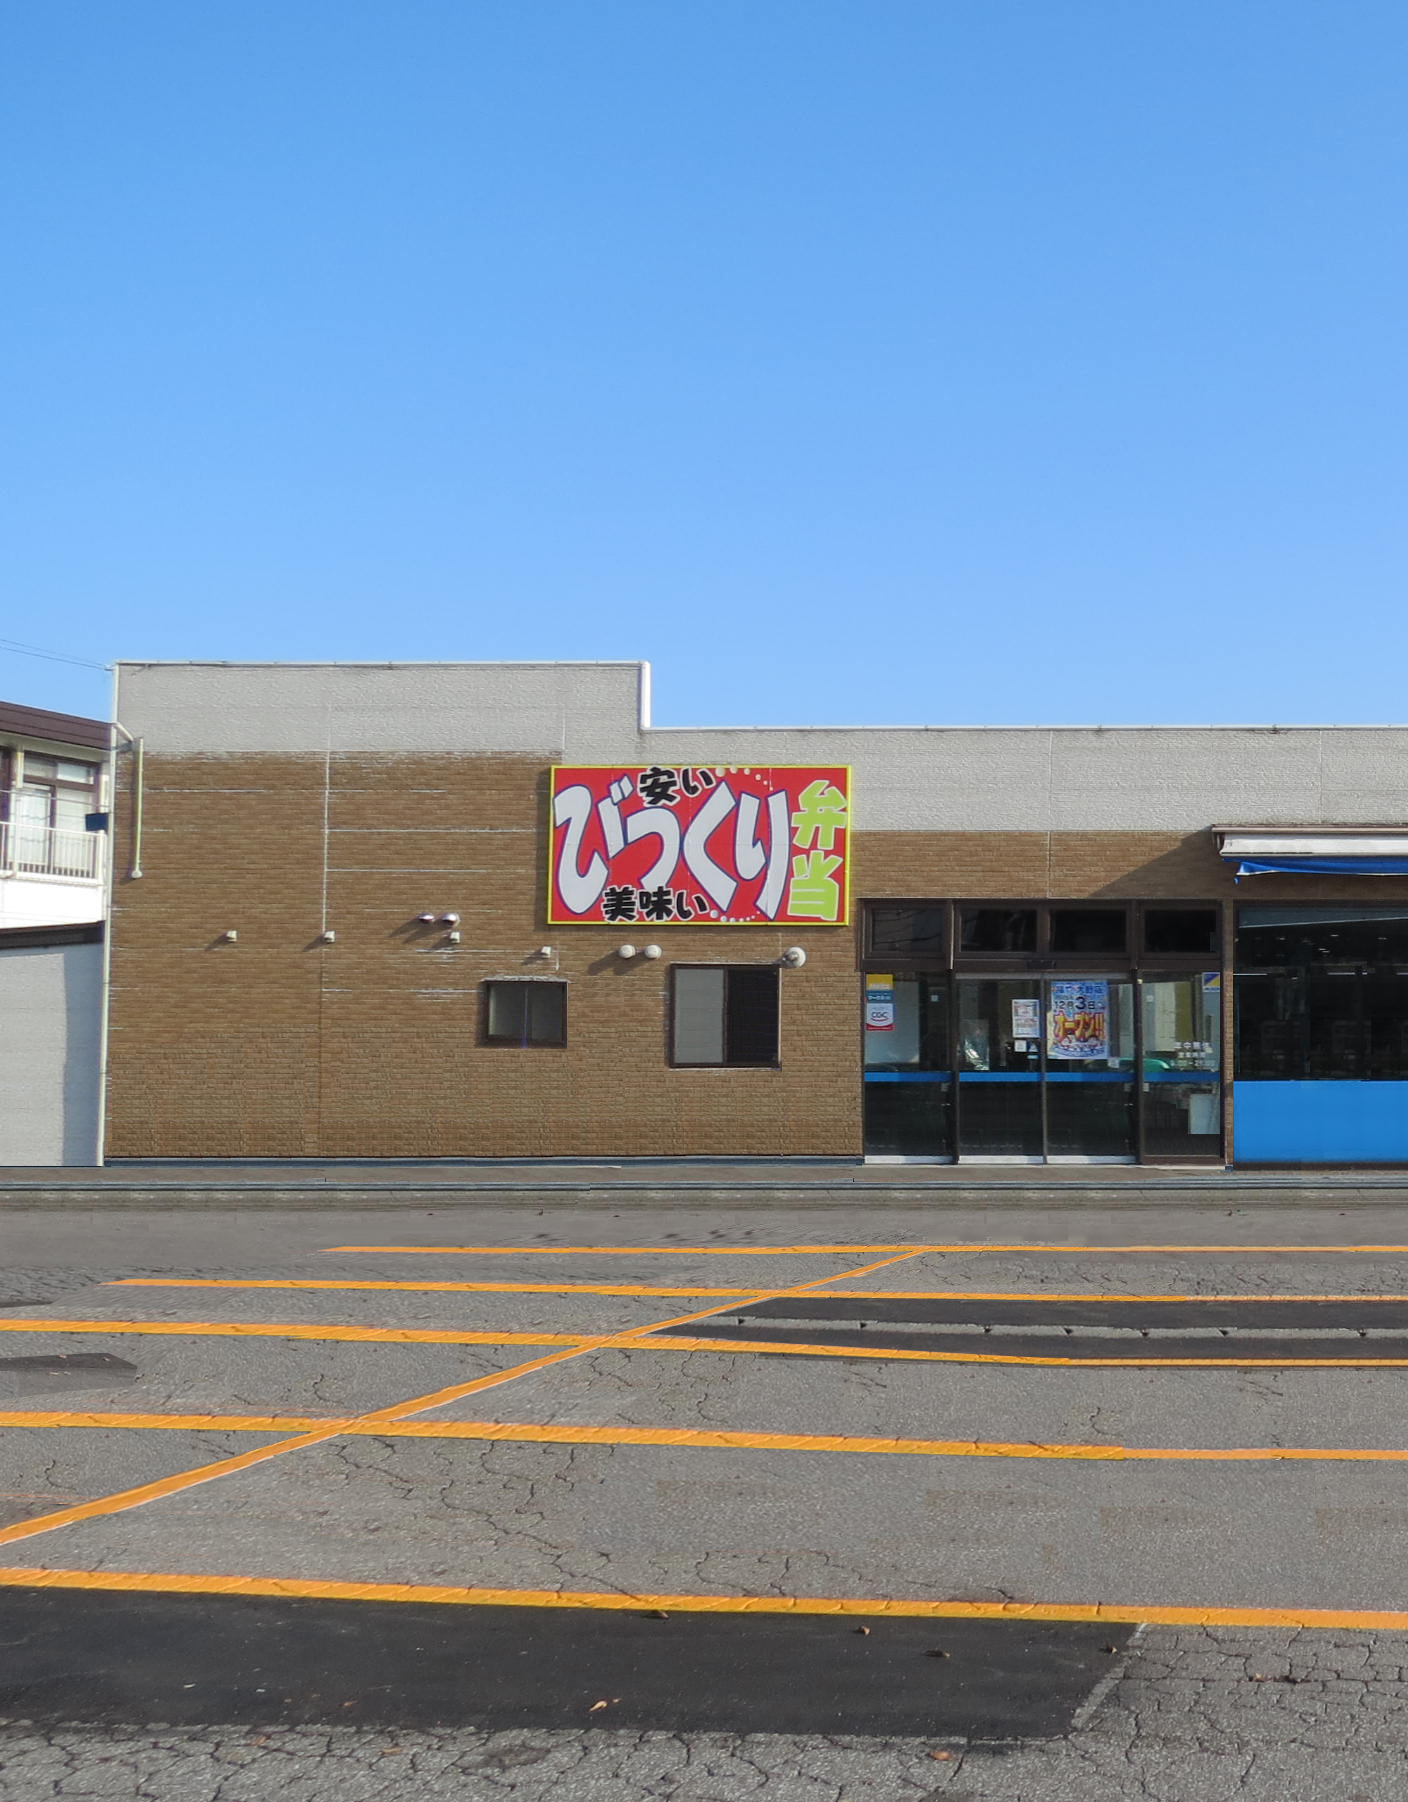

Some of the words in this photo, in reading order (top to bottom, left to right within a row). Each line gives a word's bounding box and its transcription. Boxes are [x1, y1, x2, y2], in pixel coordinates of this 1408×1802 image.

[553, 775, 791, 920] びっくり
[786, 780, 849, 920] 弁当
